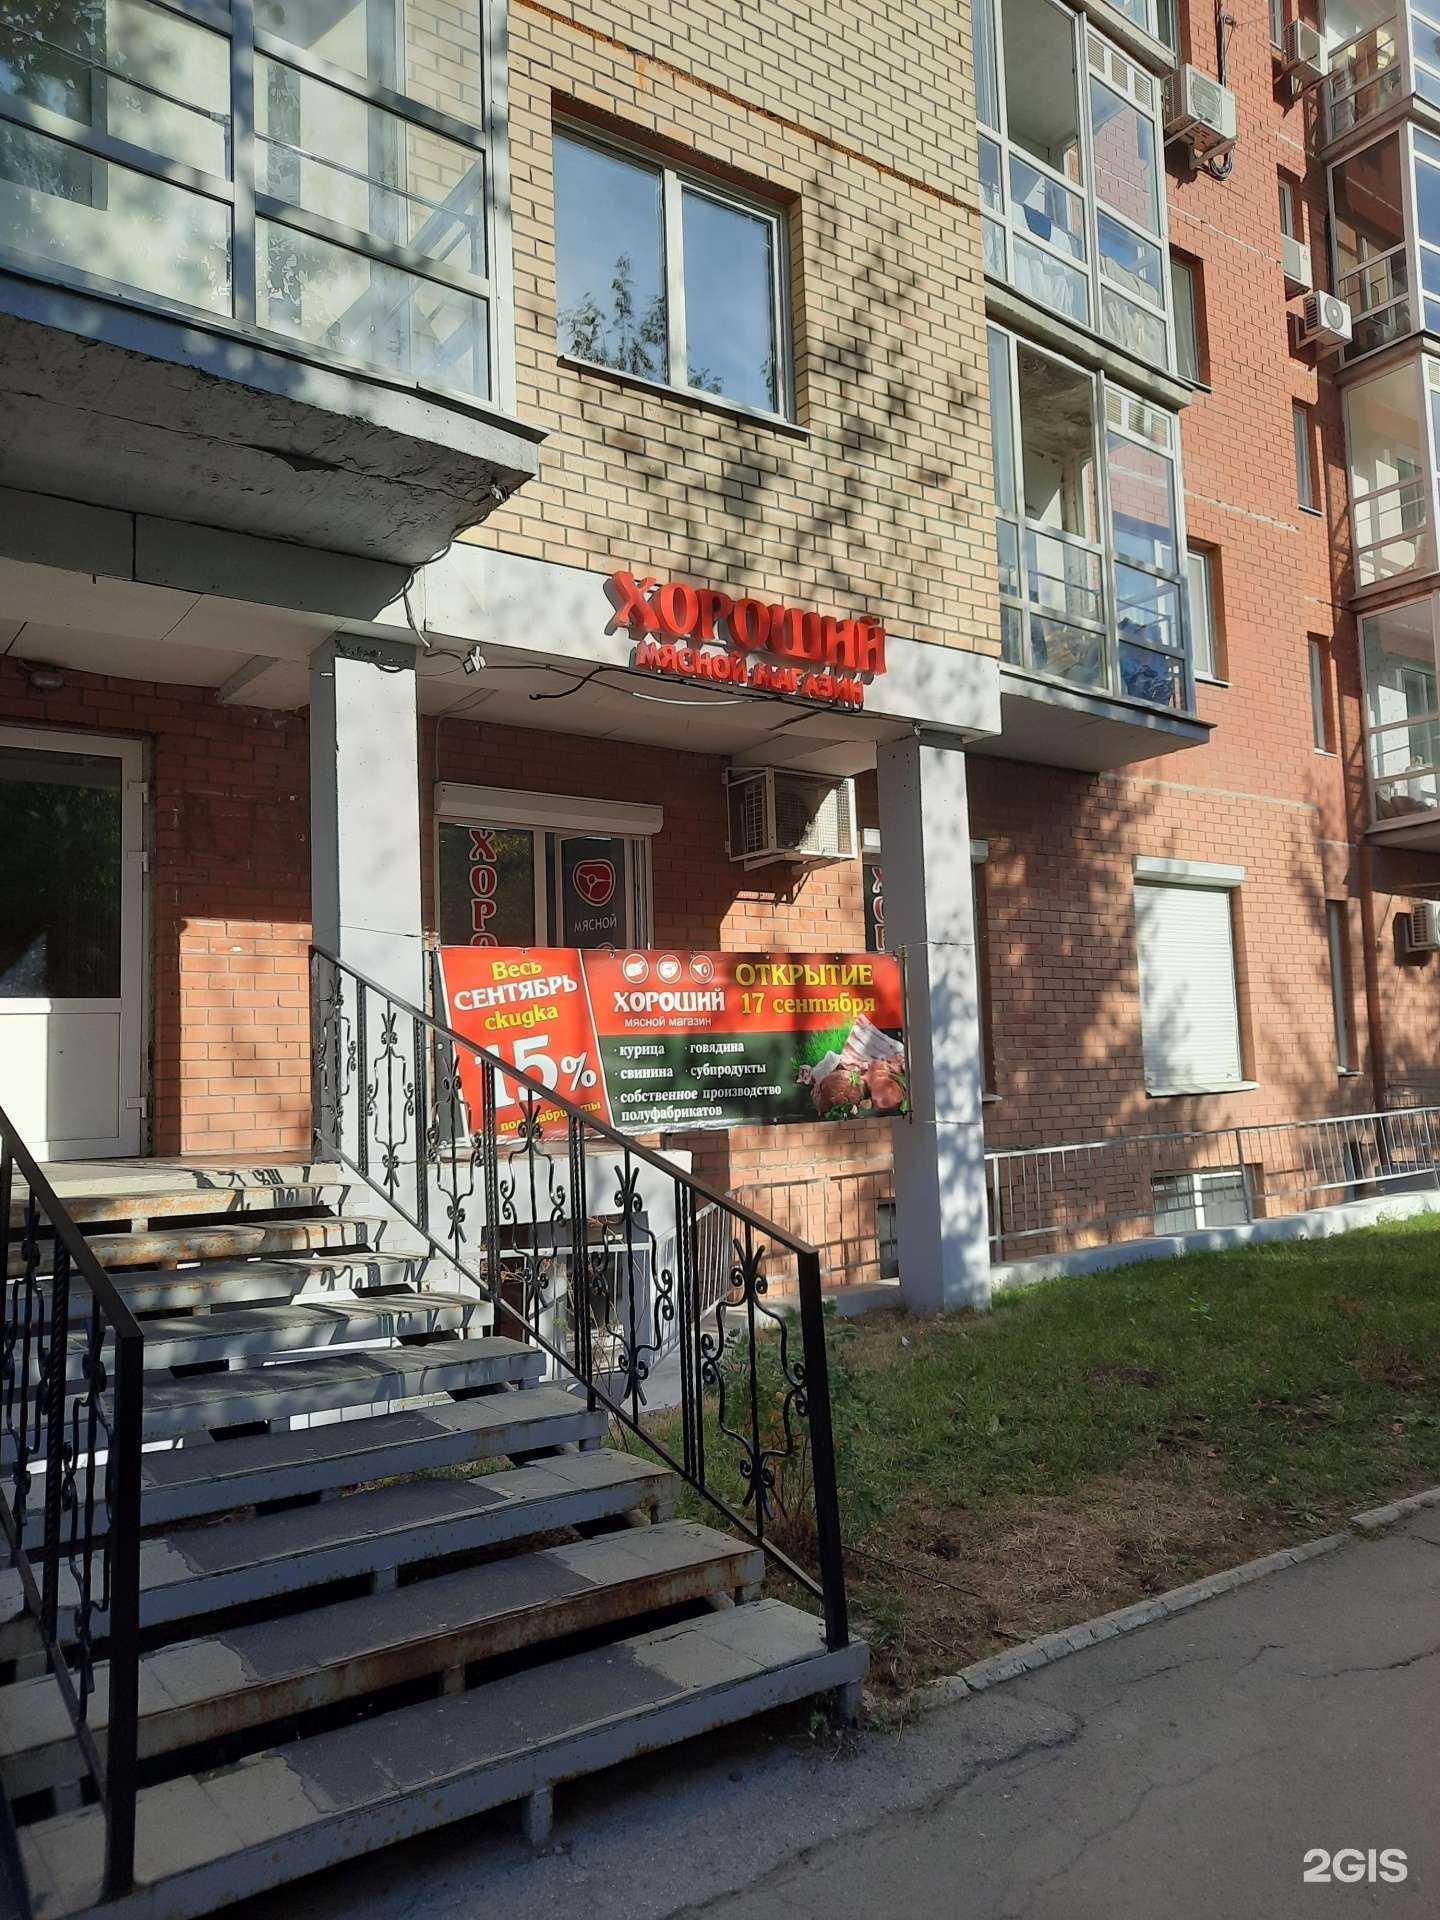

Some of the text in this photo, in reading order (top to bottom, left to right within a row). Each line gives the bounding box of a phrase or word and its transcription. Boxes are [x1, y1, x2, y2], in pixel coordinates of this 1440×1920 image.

[608, 570, 887, 675] ХОРОШИЙ
[635, 640, 864, 704] МЯСНОЙ МАГАЗИН
[574, 913, 617, 932] МЯСНОЙ
[490, 961, 542, 981] Весь
[735, 963, 874, 987] ОТКРЫТИЕ
[454, 974, 578, 1011] СЕНТЯБРЬ
[613, 988, 726, 1013] ХОРОШИЙ
[741, 992, 876, 1018] 17 сентября
[624, 1016, 712, 1028] мясной магазин
[619, 1044, 665, 1060] курица
[690, 1042, 745, 1055] говядина
[620, 1067, 674, 1080] свинина
[690, 1062, 767, 1080] субпродукты
[620, 1084, 782, 1104] собственное производство
[621, 1105, 723, 1123] полуфабрикатов
